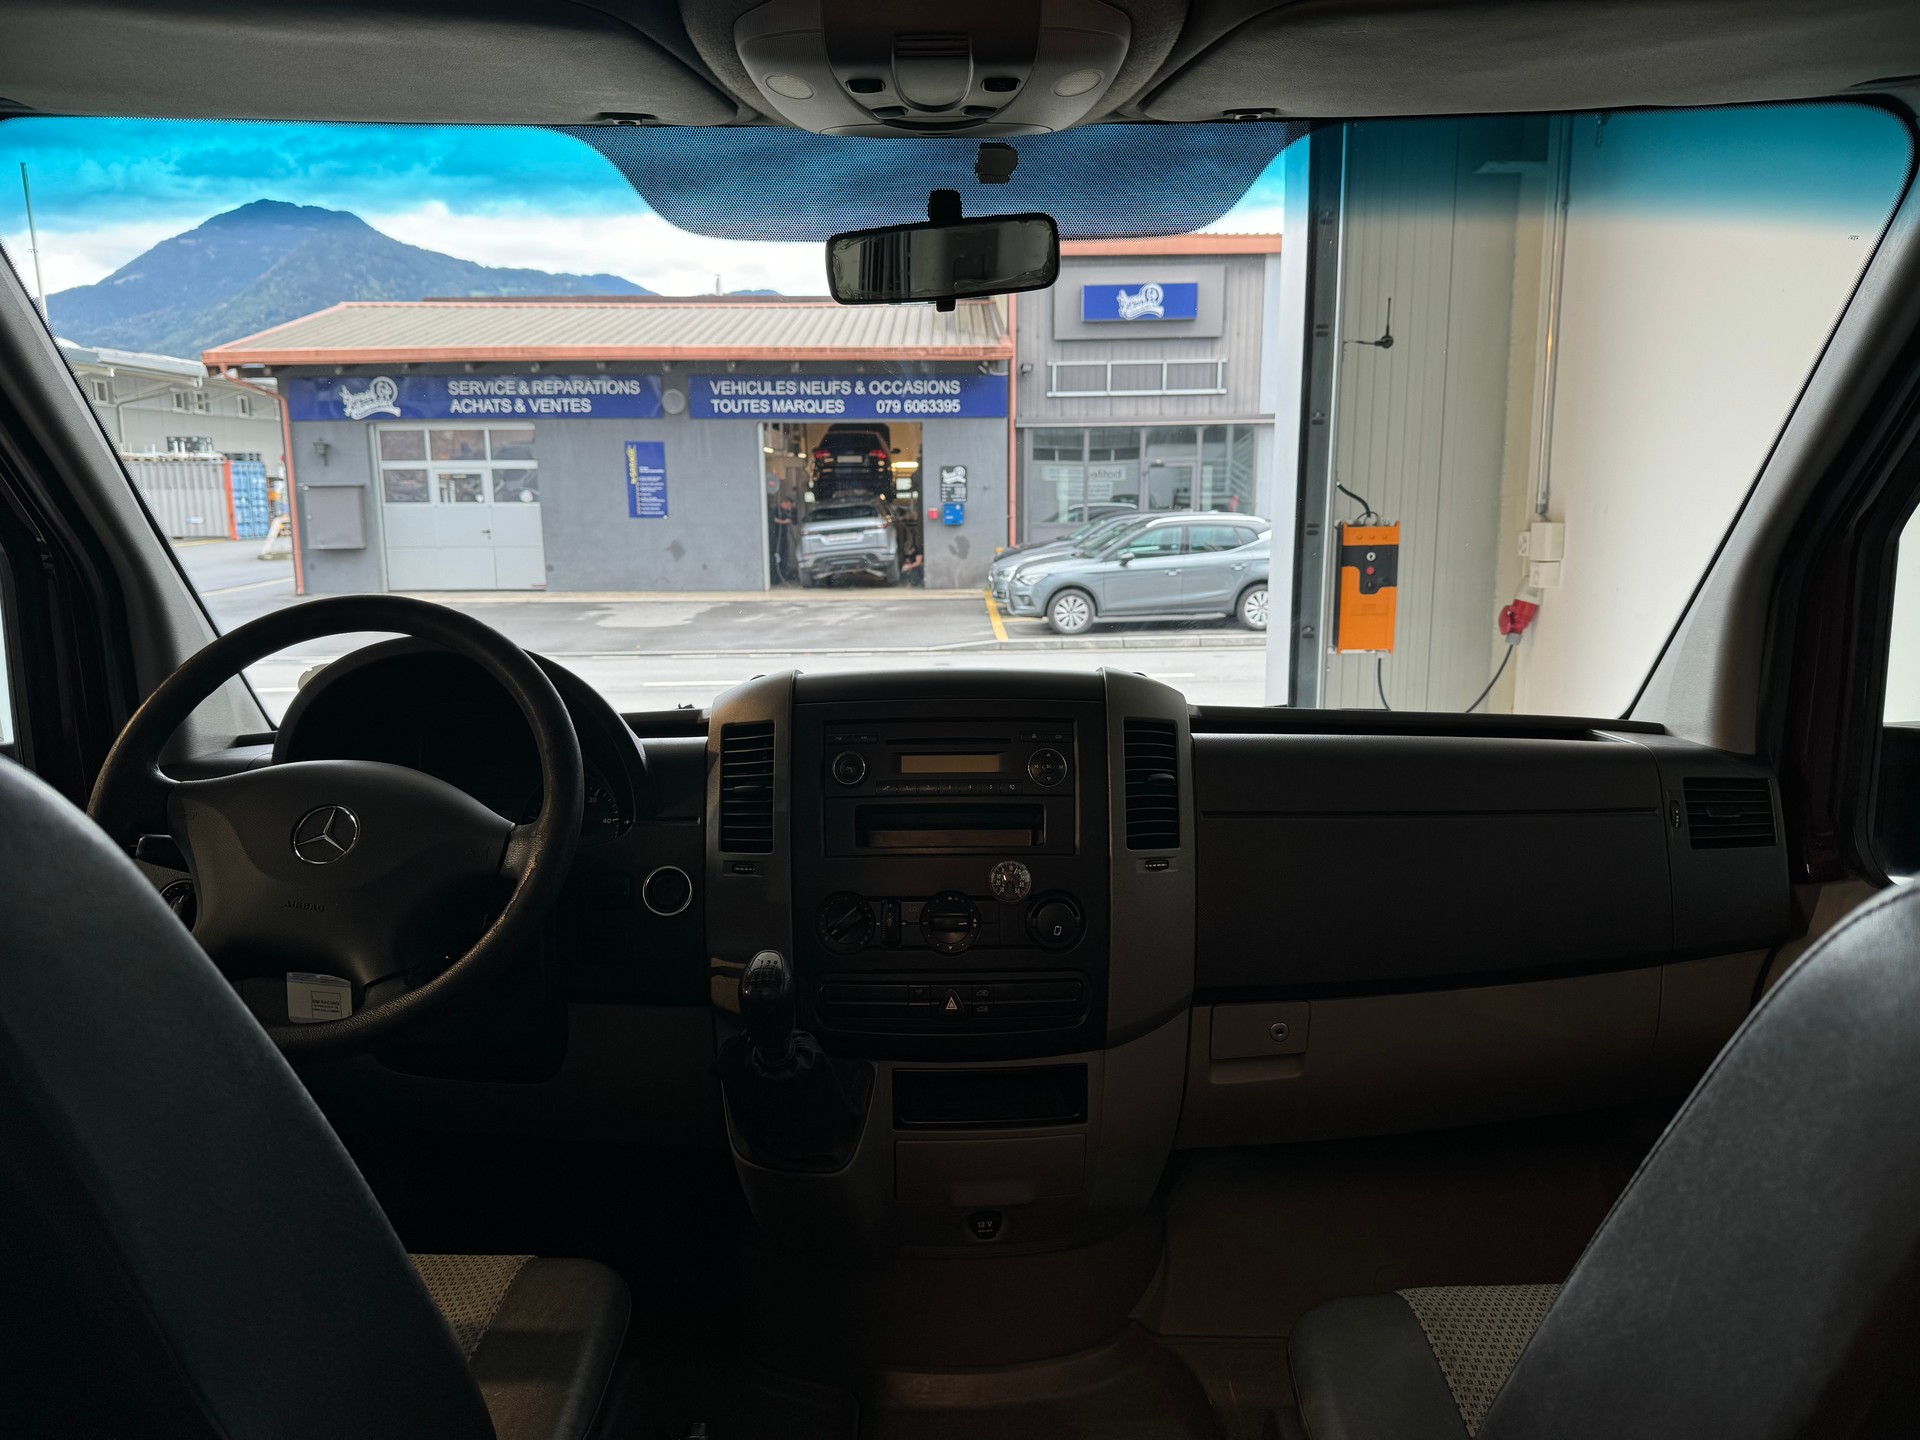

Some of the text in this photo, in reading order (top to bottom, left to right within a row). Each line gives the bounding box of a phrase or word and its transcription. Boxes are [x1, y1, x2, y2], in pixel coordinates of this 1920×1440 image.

[448, 379, 641, 396] SERVICE & REPARATIONS
[709, 379, 961, 395] VEHICULES NEUFS & OCCASIONS
[450, 398, 592, 413] ACHATS & VENTES
[710, 399, 846, 413] TOUTES MARQUES
[876, 399, 961, 413] 079 6063395
[283, 900, 325, 912] AIRBAG
[987, 1220, 992, 1228] V
